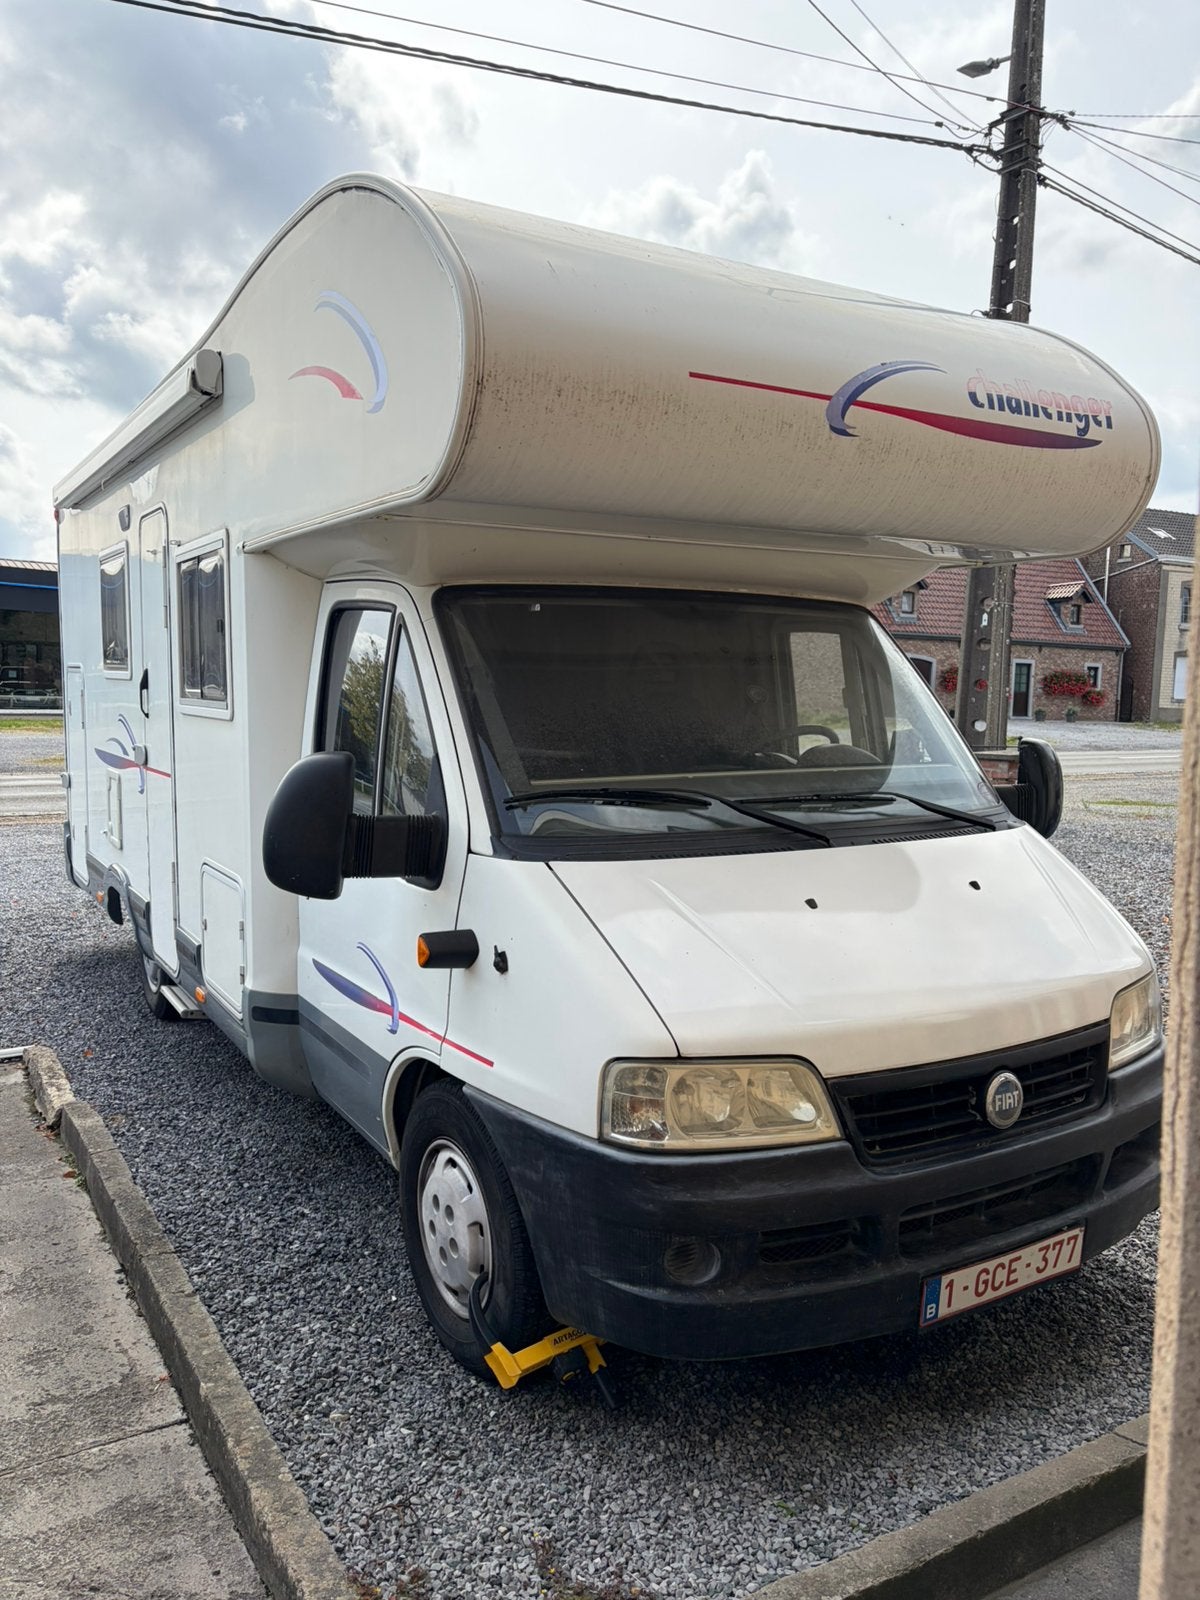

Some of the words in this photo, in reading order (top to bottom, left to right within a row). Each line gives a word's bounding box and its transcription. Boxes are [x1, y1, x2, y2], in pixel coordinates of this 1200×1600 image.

[995, 1091, 1019, 1111] FIAT
[926, 1303, 937, 1319] B
[944, 1234, 1079, 1308] 1-GCE-377
